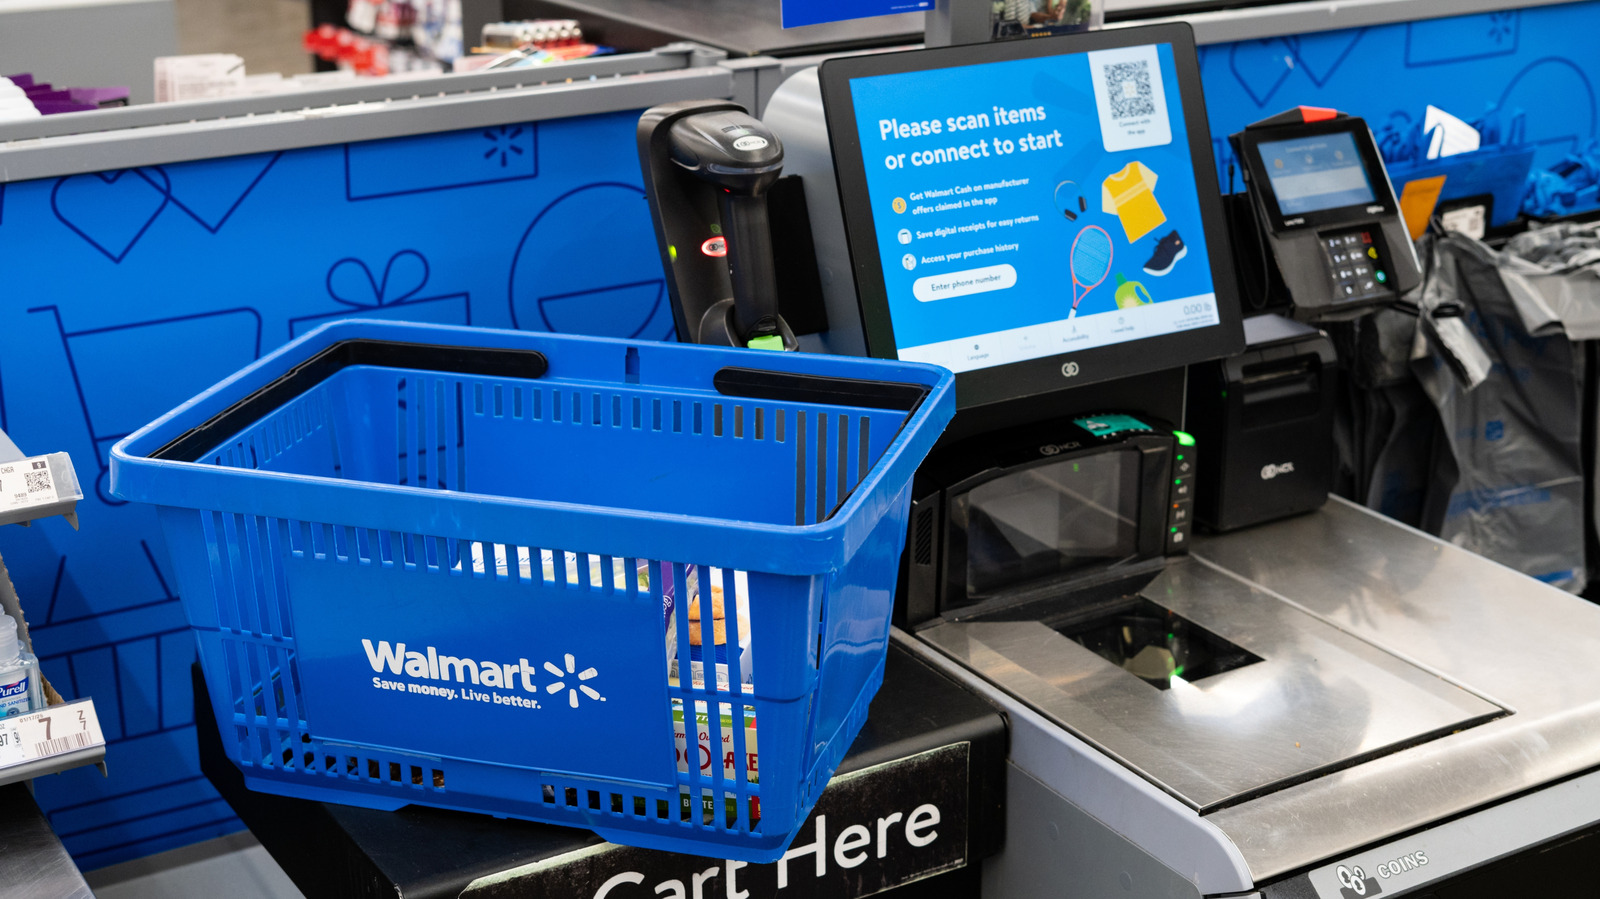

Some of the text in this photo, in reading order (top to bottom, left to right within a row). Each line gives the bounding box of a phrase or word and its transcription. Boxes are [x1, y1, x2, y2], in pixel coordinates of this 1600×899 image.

[879, 106, 1047, 141] Please scan items
[885, 129, 1064, 170] or connect to start
[909, 177, 1030, 201] Get Walmart Cash on manufacturer
[912, 196, 998, 215] offers claimed in the app
[916, 214, 1040, 240] Save digital receipts for easy returns
[921, 242, 1019, 265] Access your purchase history
[930, 273, 1001, 292] Enter phone number
[361, 638, 537, 692] Walmart
[372, 676, 542, 709] Save money. Live better.
[38, 716, 52, 741] 7
[80, 720, 87, 730] 7
[777, 803, 941, 890] Here
[1377, 850, 1429, 879] COINS
